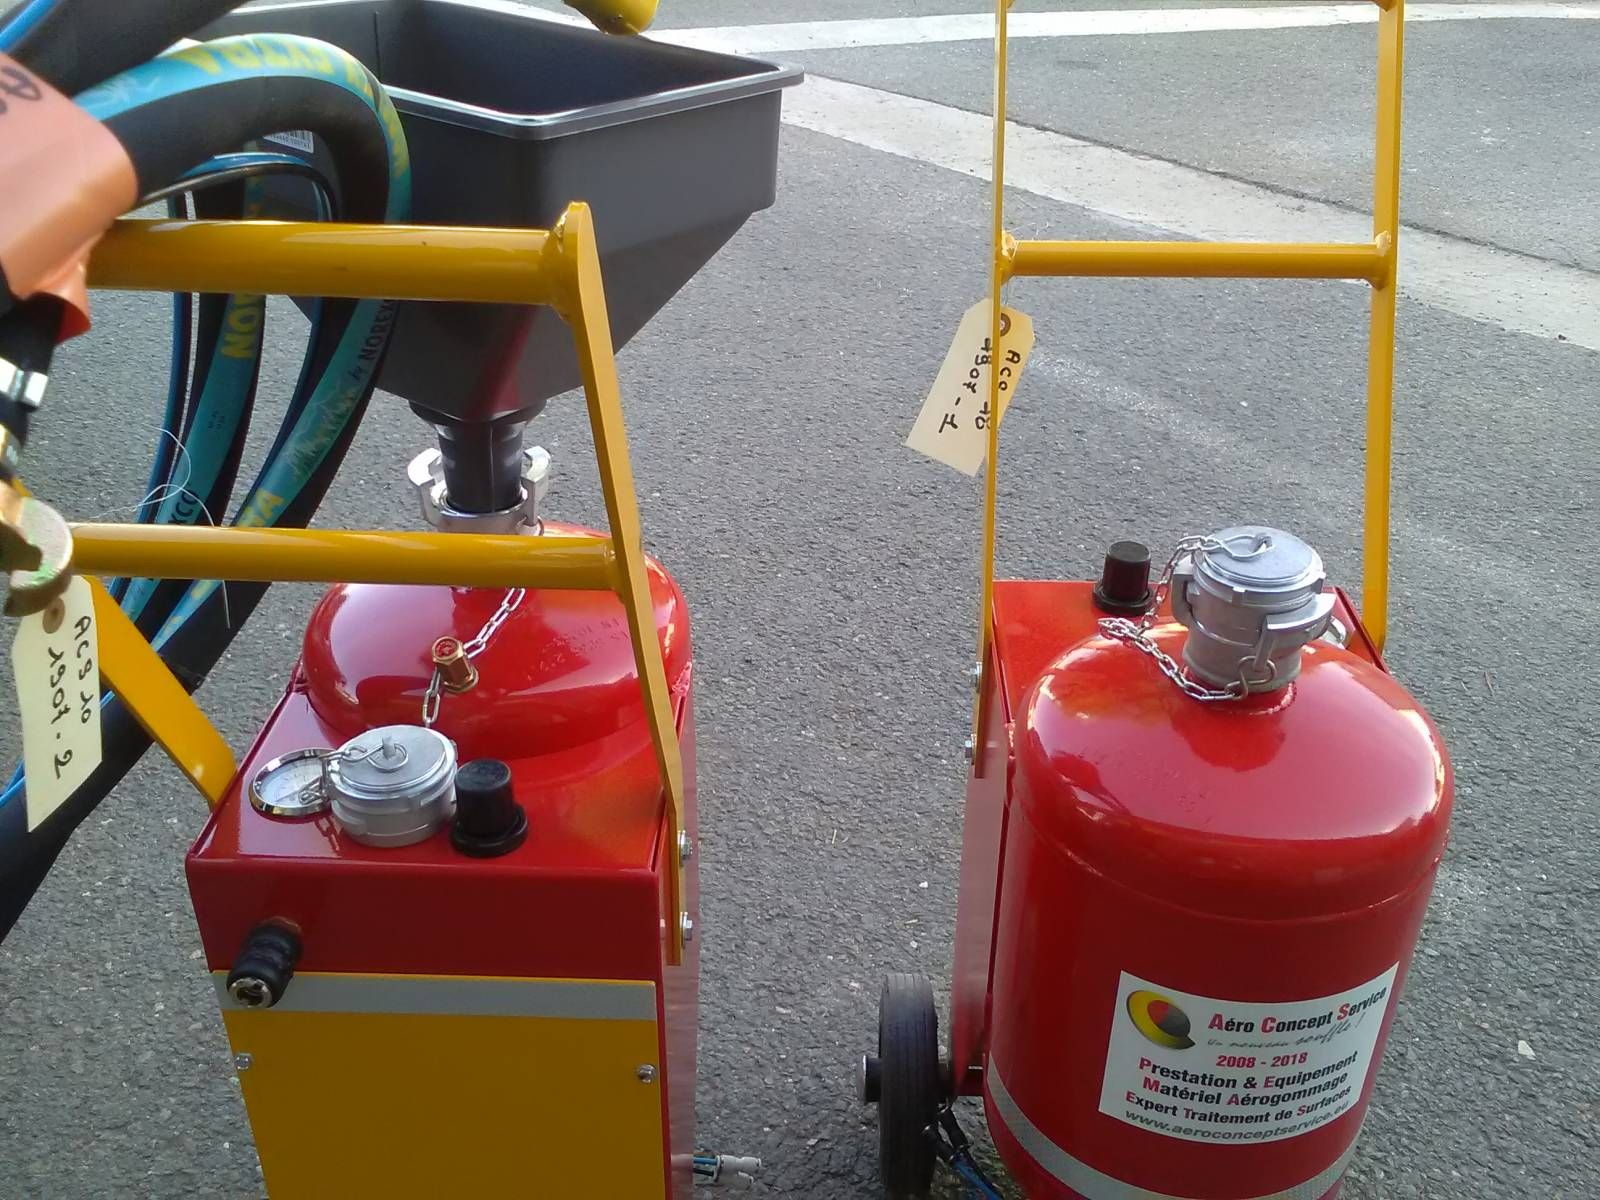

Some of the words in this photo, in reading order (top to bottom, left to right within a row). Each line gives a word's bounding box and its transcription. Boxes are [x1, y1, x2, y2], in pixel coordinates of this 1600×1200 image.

[1208, 1013, 1254, 1033] Aéro
[1261, 1011, 1333, 1033] Concept
[1337, 986, 1387, 1021] Service
[1139, 1057, 1237, 1089] Prestation
[1243, 1077, 1258, 1089] &
[1264, 1050, 1359, 1090] Equipement
[1216, 1054, 1255, 1069] 2008
[1272, 1052, 1308, 1068] 2018
[1125, 1091, 1177, 1117] Expert
[1183, 1107, 1270, 1125] Traitement
[1274, 1109, 1293, 1122] de
[1296, 1085, 1352, 1116] Surfaces
[1142, 1076, 1222, 1106] Matériel
[1227, 1072, 1348, 1107] Aérogommage
[1125, 1101, 1349, 1141] www.aeroconceptservice.eu
